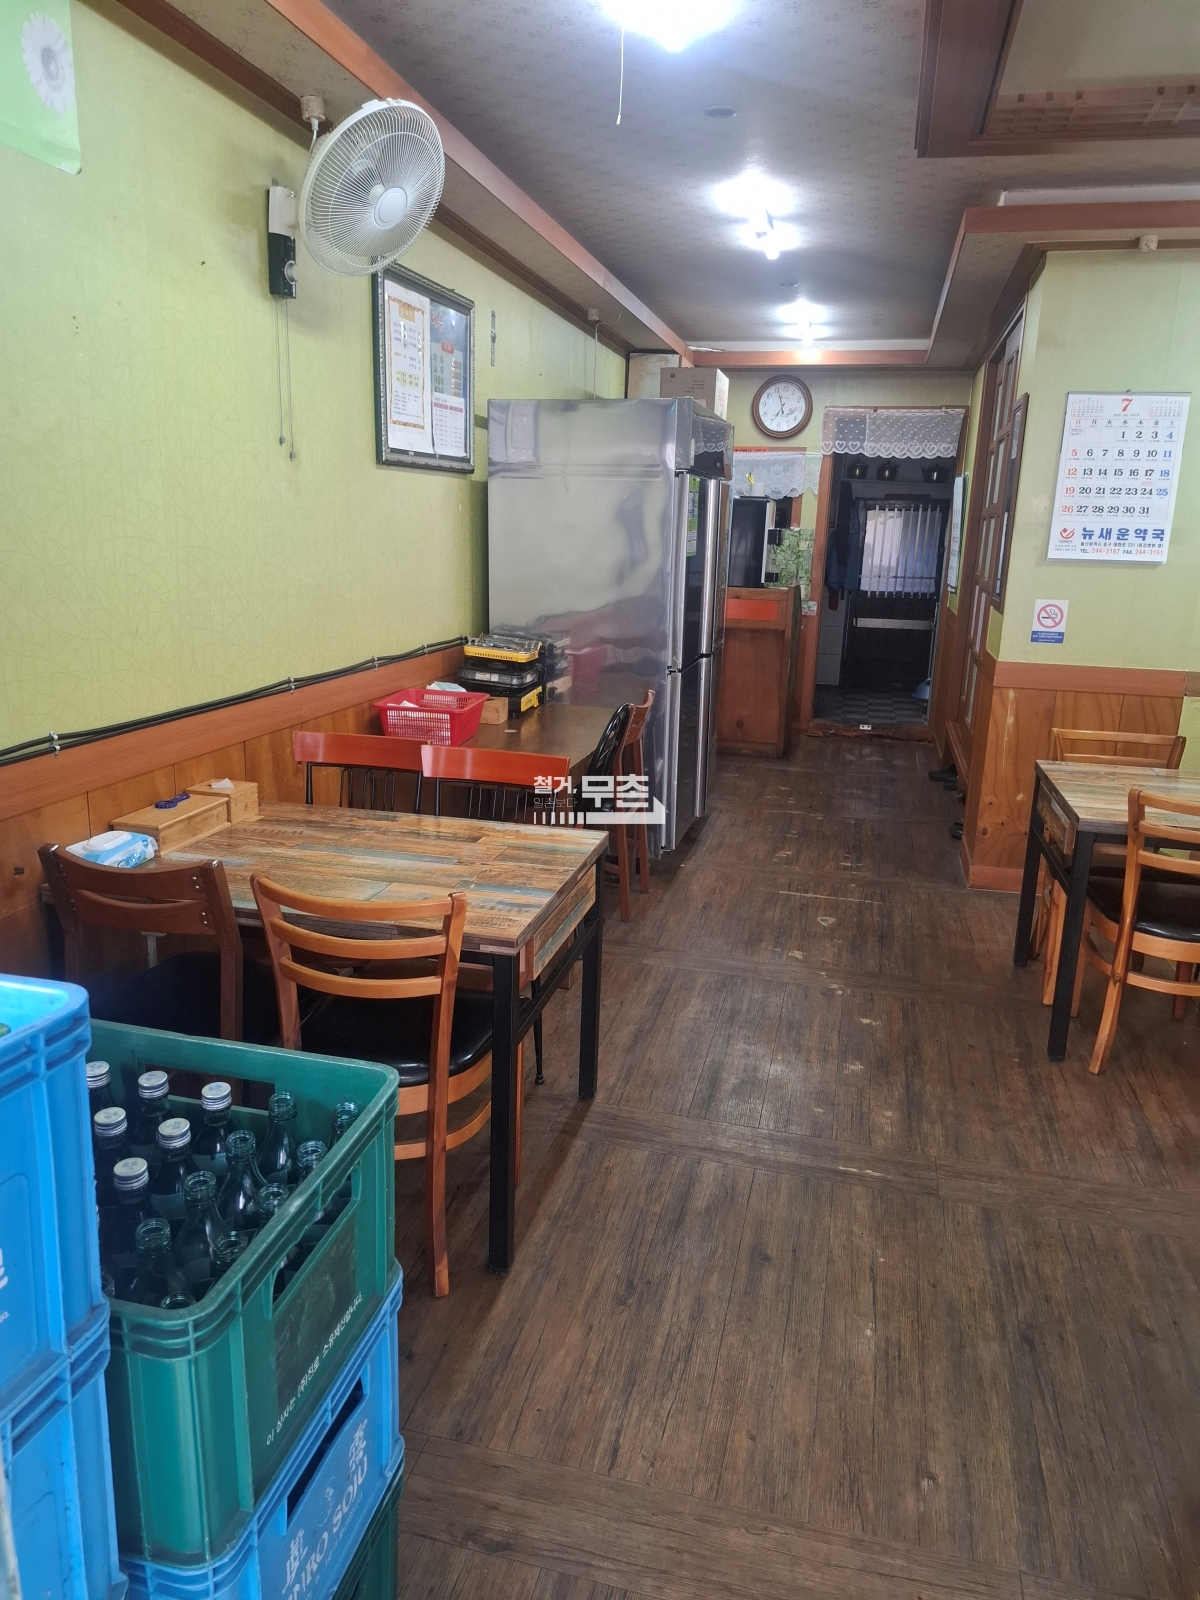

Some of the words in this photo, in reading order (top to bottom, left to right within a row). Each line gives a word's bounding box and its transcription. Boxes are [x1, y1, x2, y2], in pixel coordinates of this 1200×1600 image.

[1121, 398, 1133, 412] 7
[1121, 430, 1126, 438] 1
[1136, 430, 1142, 438] 2
[1151, 430, 1158, 439] 3
[1166, 431, 1174, 440] 4
[1072, 448, 1078, 456] 5
[1086, 448, 1093, 456] 6
[1102, 448, 1108, 456] 7
[1118, 448, 1124, 457] 8
[1133, 449, 1140, 458] 9
[1147, 450, 1158, 458] 10
[1163, 450, 1172, 458] 11
[1082, 468, 1092, 476] 13
[1098, 468, 1108, 476] 14
[1113, 468, 1123, 476] 15
[1129, 468, 1139, 476] 16
[1160, 469, 1170, 477] 18
[1079, 486, 1092, 494] 20
[1110, 487, 1122, 495] 22
[1082, 527, 1164, 541] 뉴새운약국
[266, 1428, 274, 1446] 이
[276, 1396, 296, 1433] 상자는
[298, 1356, 320, 1398] (주)진로
[332, 1453, 368, 1534] SOJU
